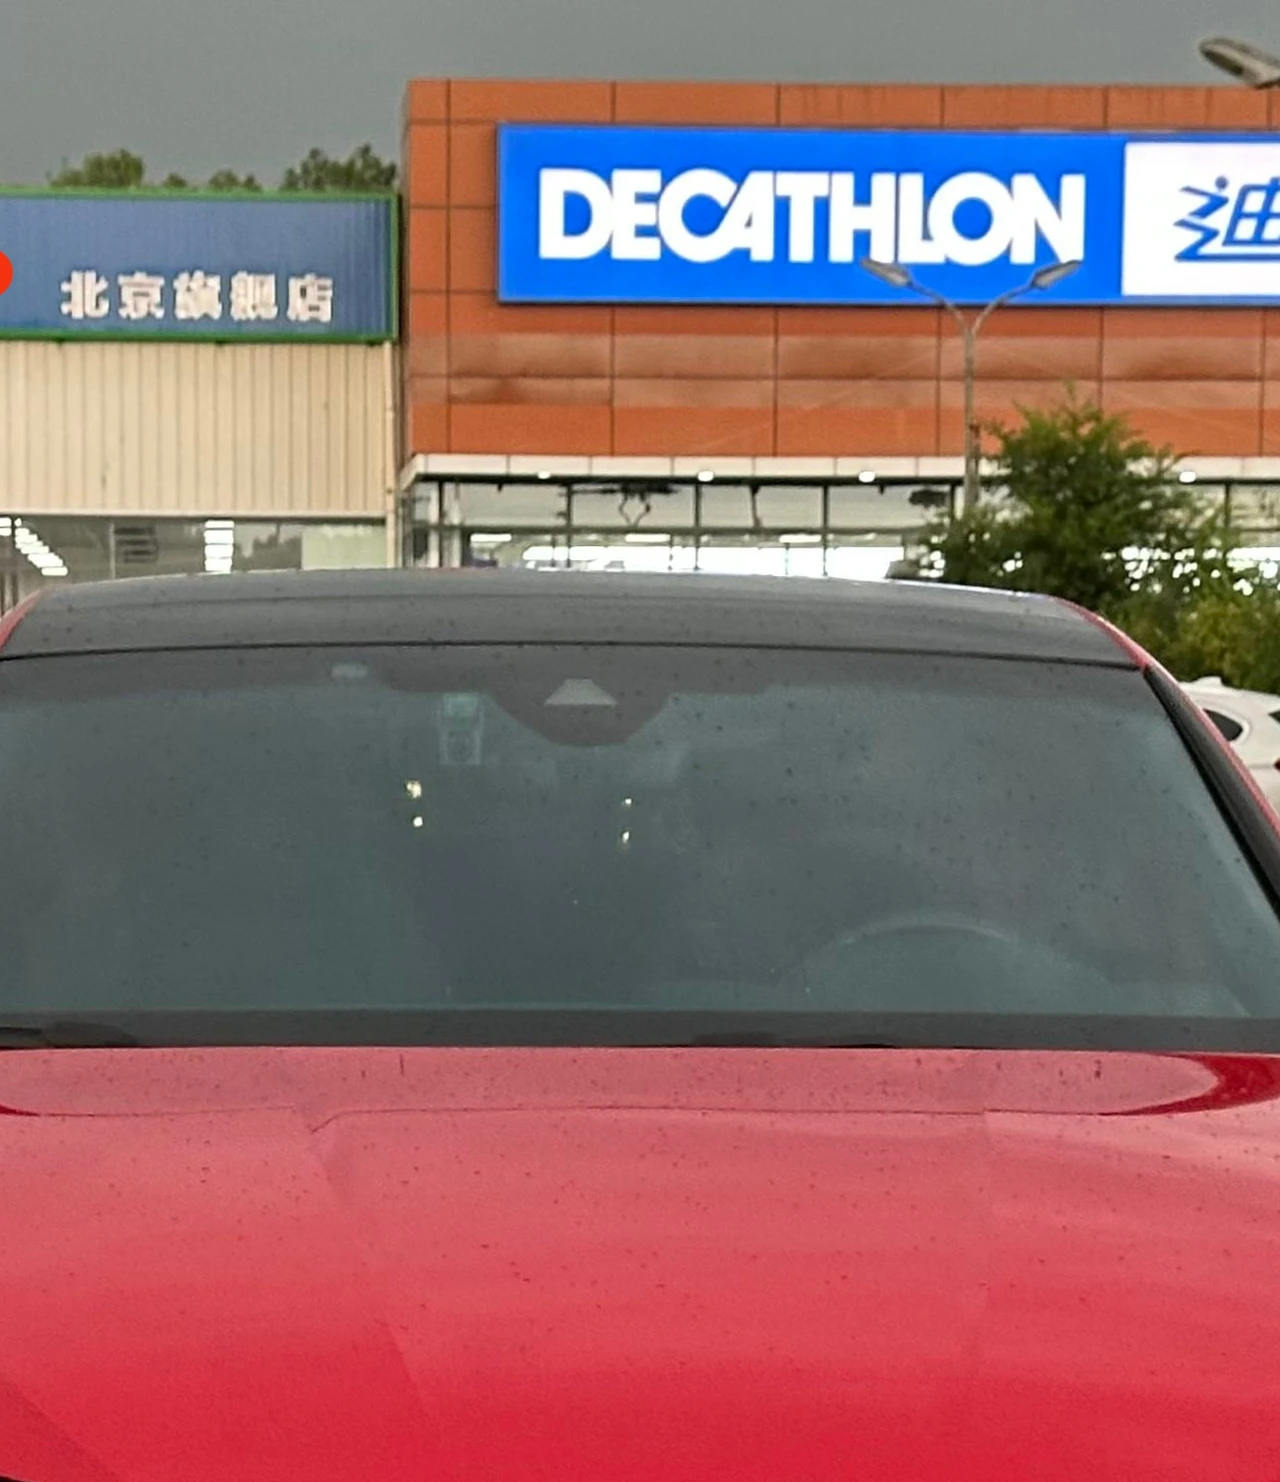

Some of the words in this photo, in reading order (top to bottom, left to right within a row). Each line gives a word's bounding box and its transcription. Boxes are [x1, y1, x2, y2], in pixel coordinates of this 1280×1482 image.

[539, 167, 1086, 266] DECATHLON
[60, 270, 333, 323] 北京旗舰店
